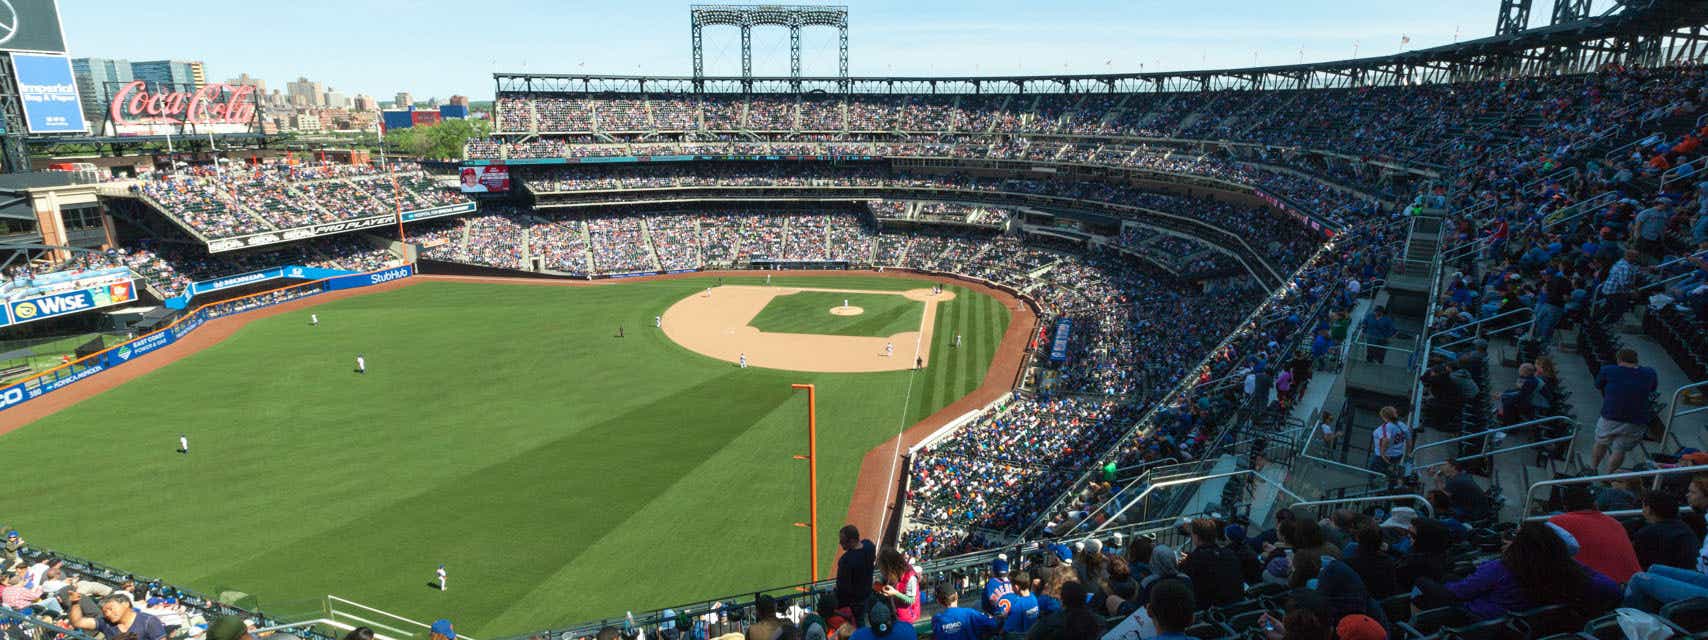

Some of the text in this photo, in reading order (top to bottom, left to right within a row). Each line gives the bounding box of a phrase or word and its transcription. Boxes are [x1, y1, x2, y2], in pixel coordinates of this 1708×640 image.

[315, 216, 394, 234] PRO PLAYER
[223, 273, 265, 285] HONDA
[370, 267, 408, 284] StubHub
[36, 293, 89, 314] WISE
[132, 339, 148, 348] EAST
